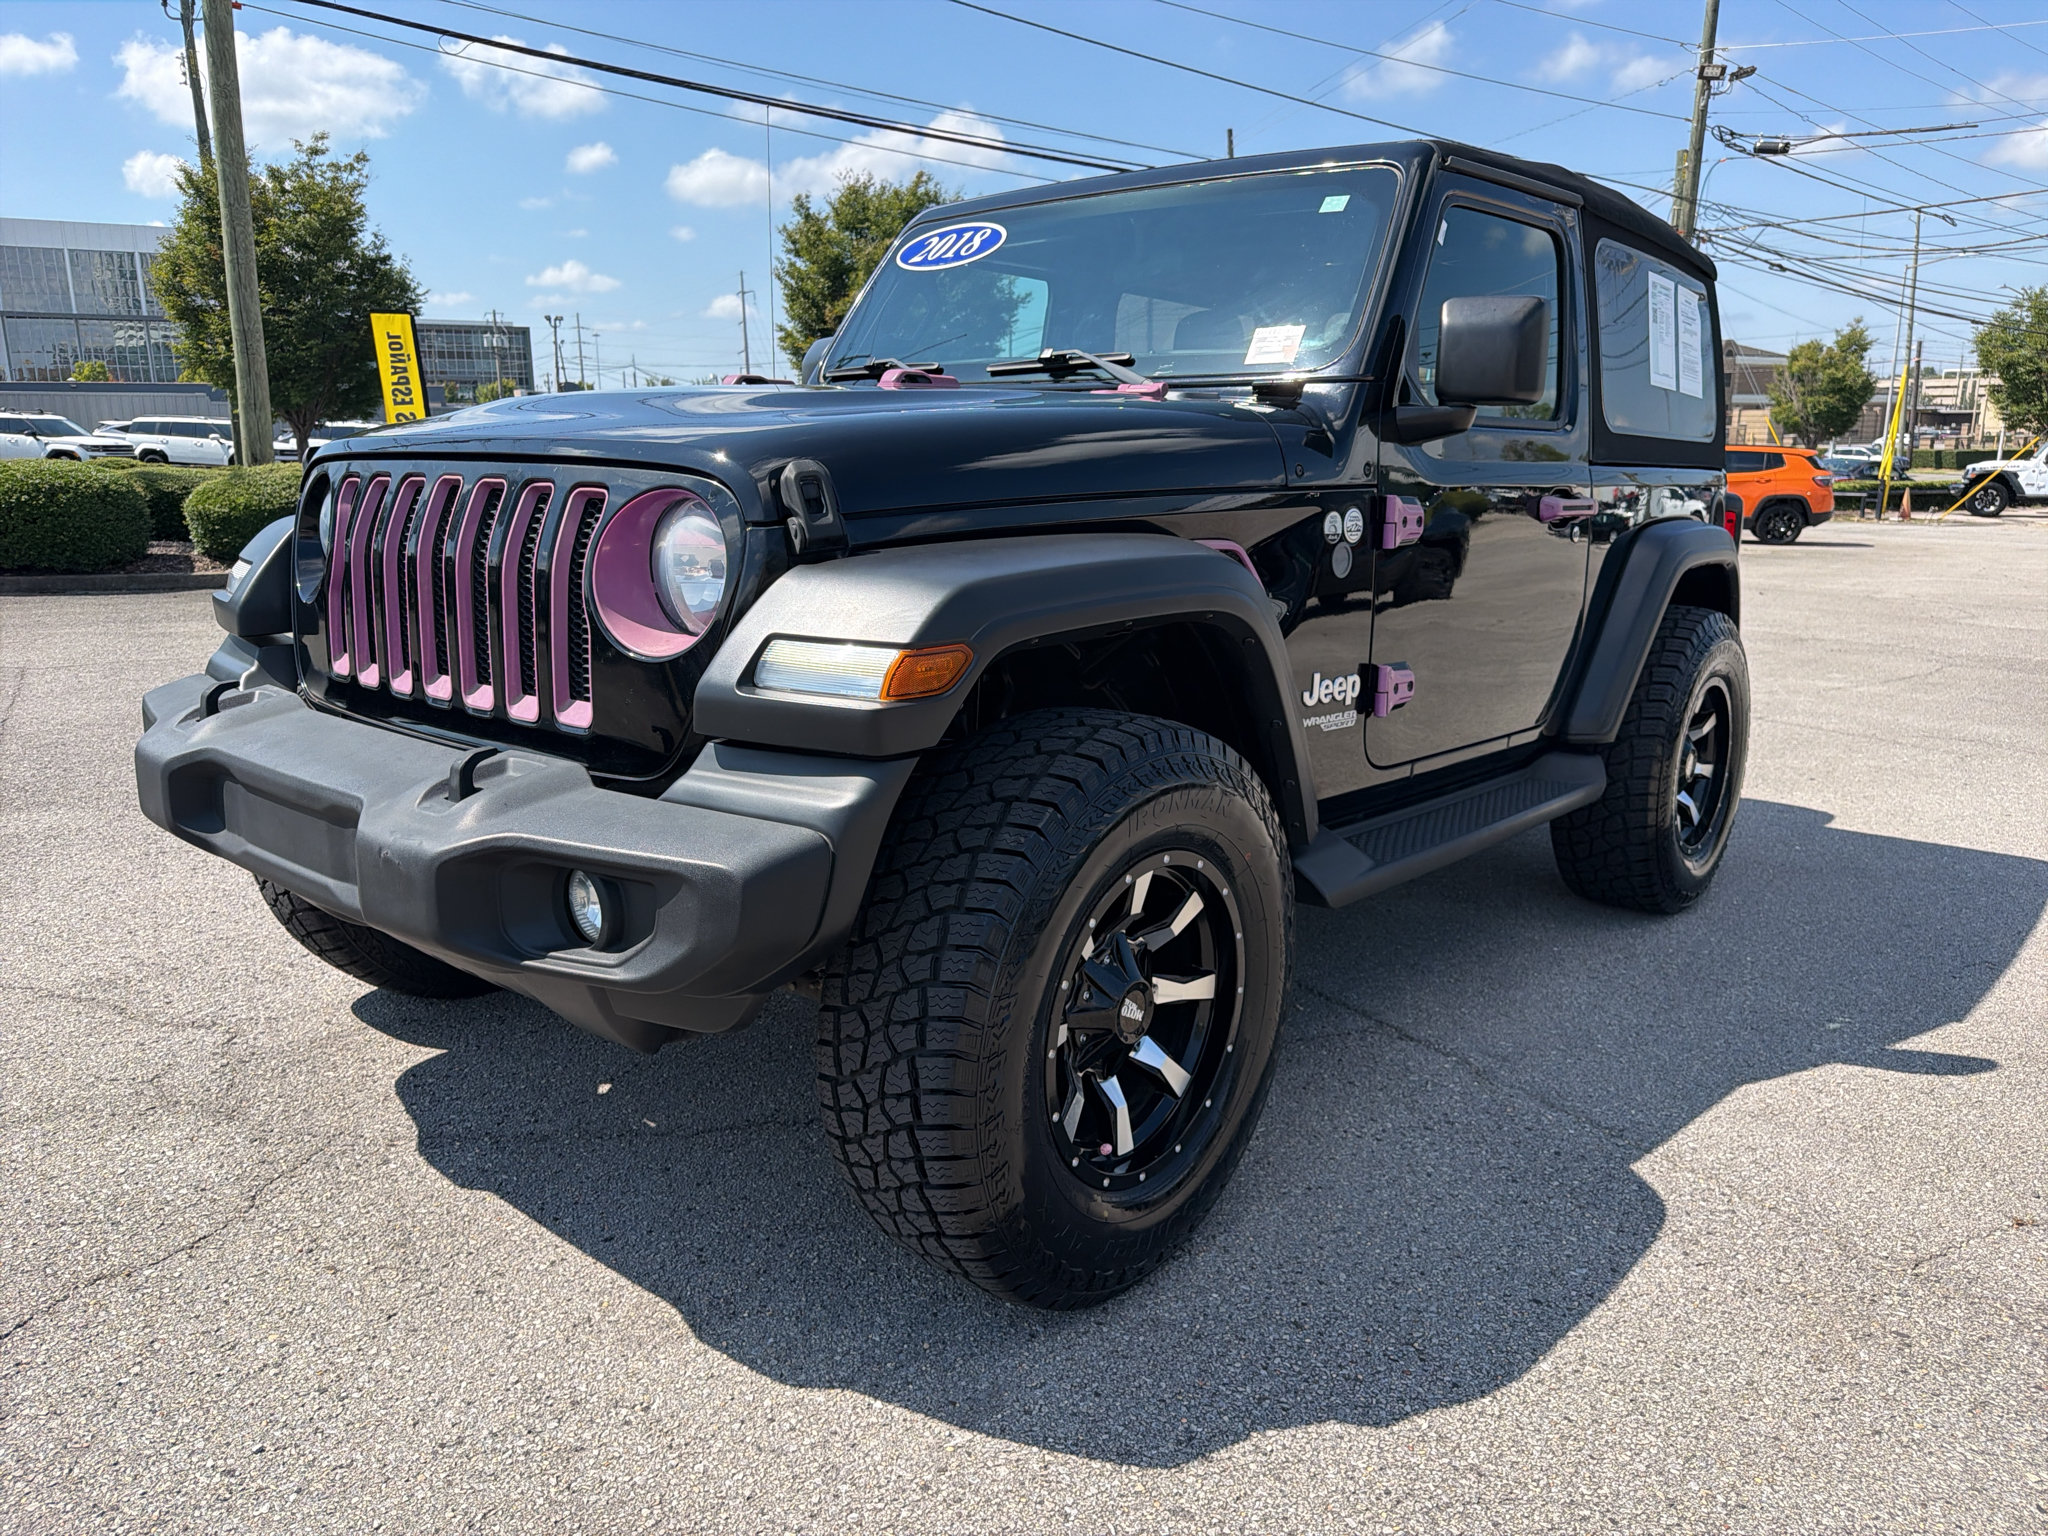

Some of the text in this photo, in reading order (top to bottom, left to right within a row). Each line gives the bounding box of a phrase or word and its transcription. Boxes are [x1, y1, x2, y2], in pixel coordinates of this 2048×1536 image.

[907, 228, 992, 263] 2018
[1302, 672, 1361, 706] Jeep
[1303, 709, 1357, 728] WRANGLER
[1322, 720, 1355, 730] SPORT
[1121, 1005, 1144, 1021] MOTO
